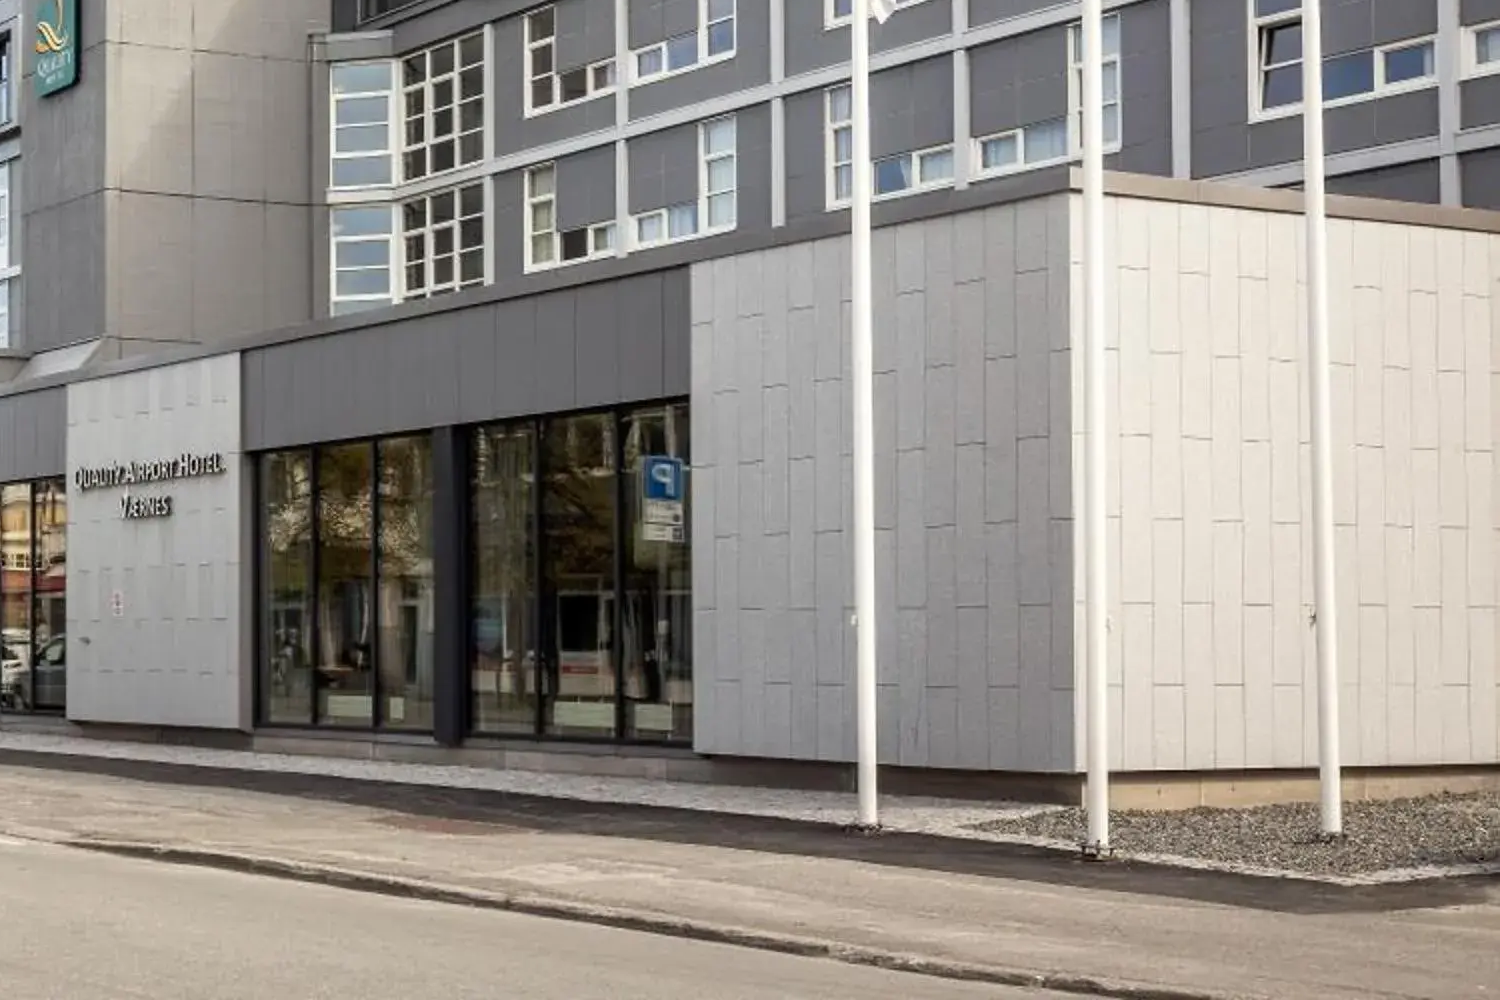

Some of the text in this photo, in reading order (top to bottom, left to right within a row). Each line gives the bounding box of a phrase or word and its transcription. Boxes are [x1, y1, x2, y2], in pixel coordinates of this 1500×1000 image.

[73, 450, 225, 491] QUALITY AIRPORT HOTEL
